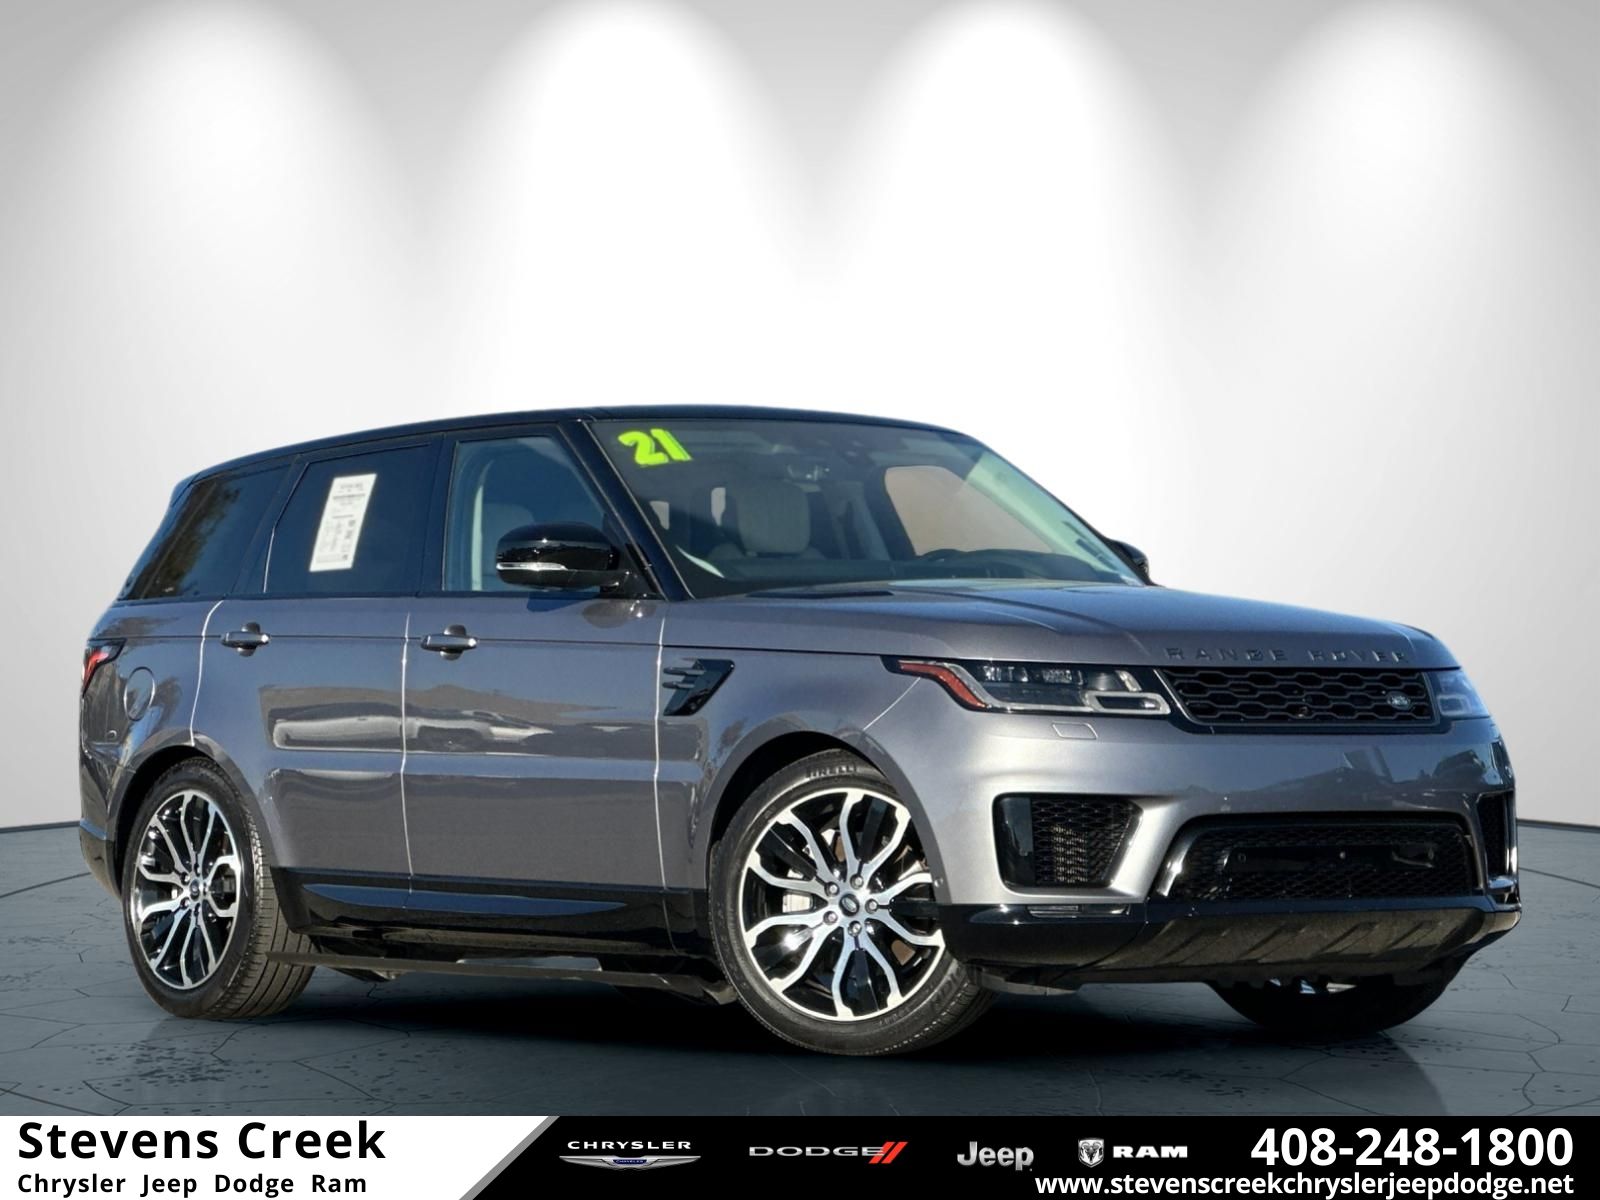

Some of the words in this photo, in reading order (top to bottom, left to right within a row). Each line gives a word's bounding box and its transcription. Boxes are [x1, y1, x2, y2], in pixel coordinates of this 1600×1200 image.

[617, 429, 692, 466] 21
[1164, 647, 1288, 662] RANGE
[1307, 649, 1408, 663] ROVER
